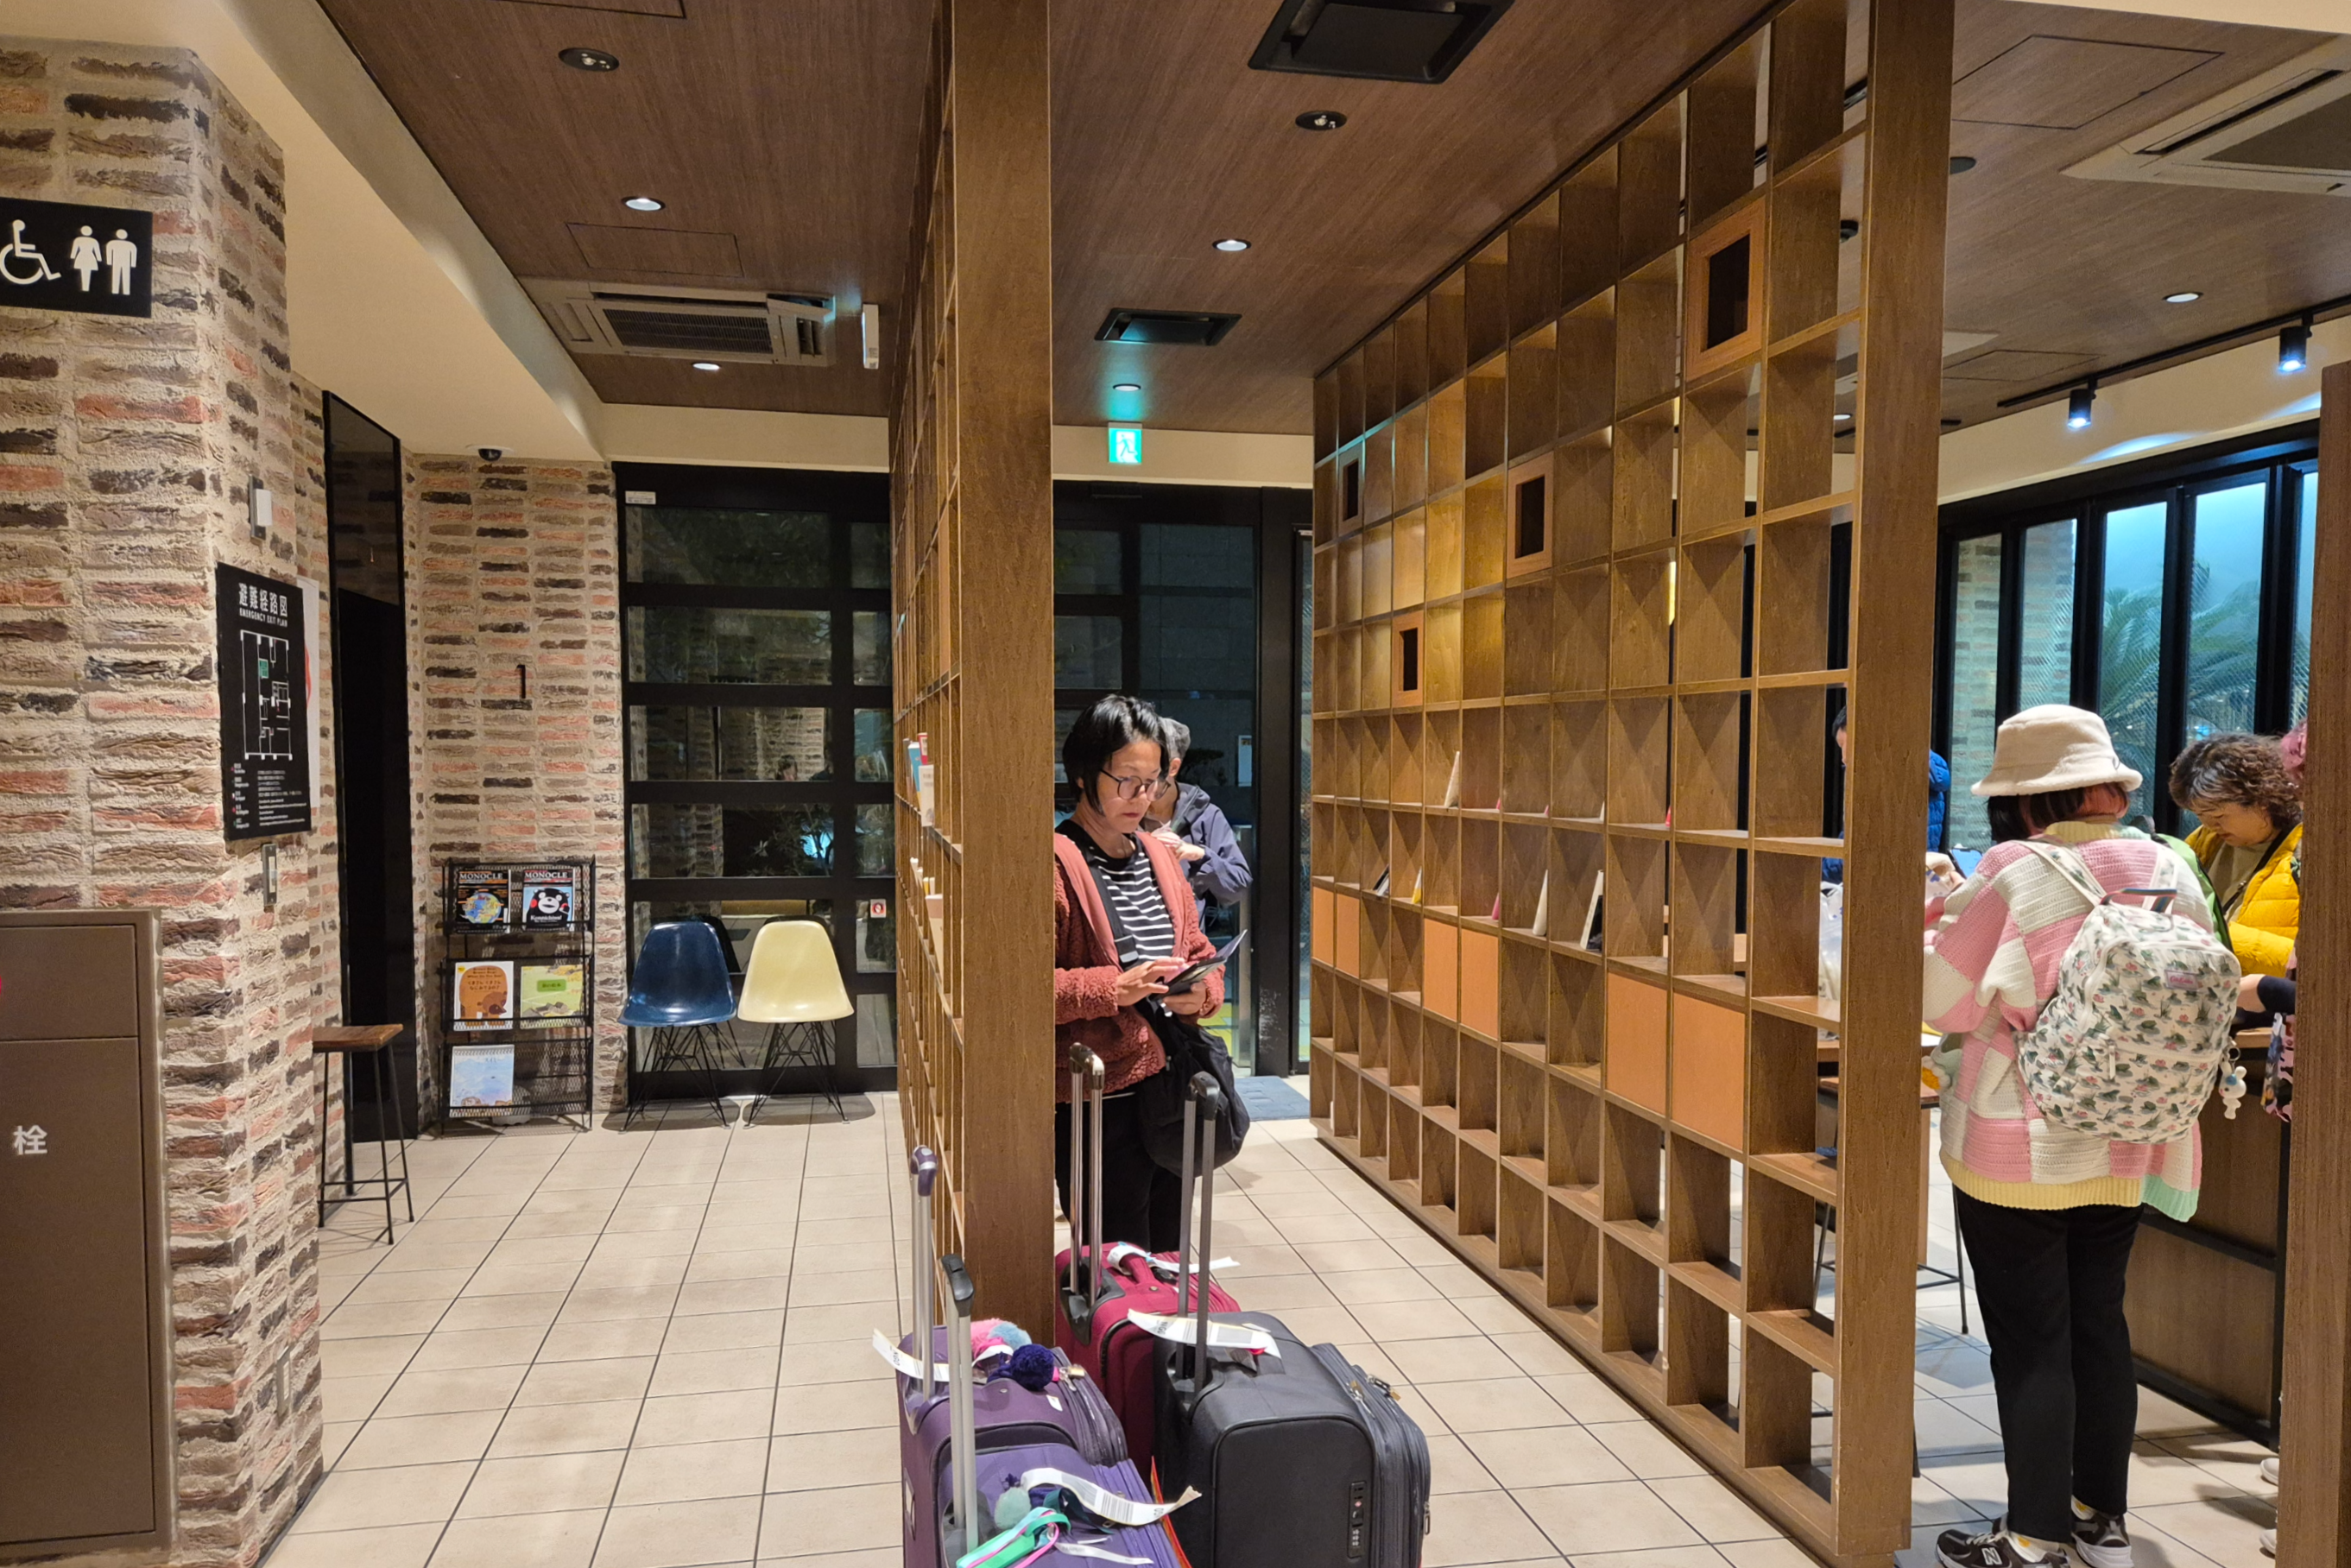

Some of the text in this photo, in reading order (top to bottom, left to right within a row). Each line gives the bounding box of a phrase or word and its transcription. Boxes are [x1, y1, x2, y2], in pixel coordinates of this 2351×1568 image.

[238, 582, 288, 617] 避難経路図
[239, 607, 288, 628] EMERGENCY EXIT PLAN
[13, 1125, 48, 1155] 栓
[1981, 1546, 2003, 1565] N
